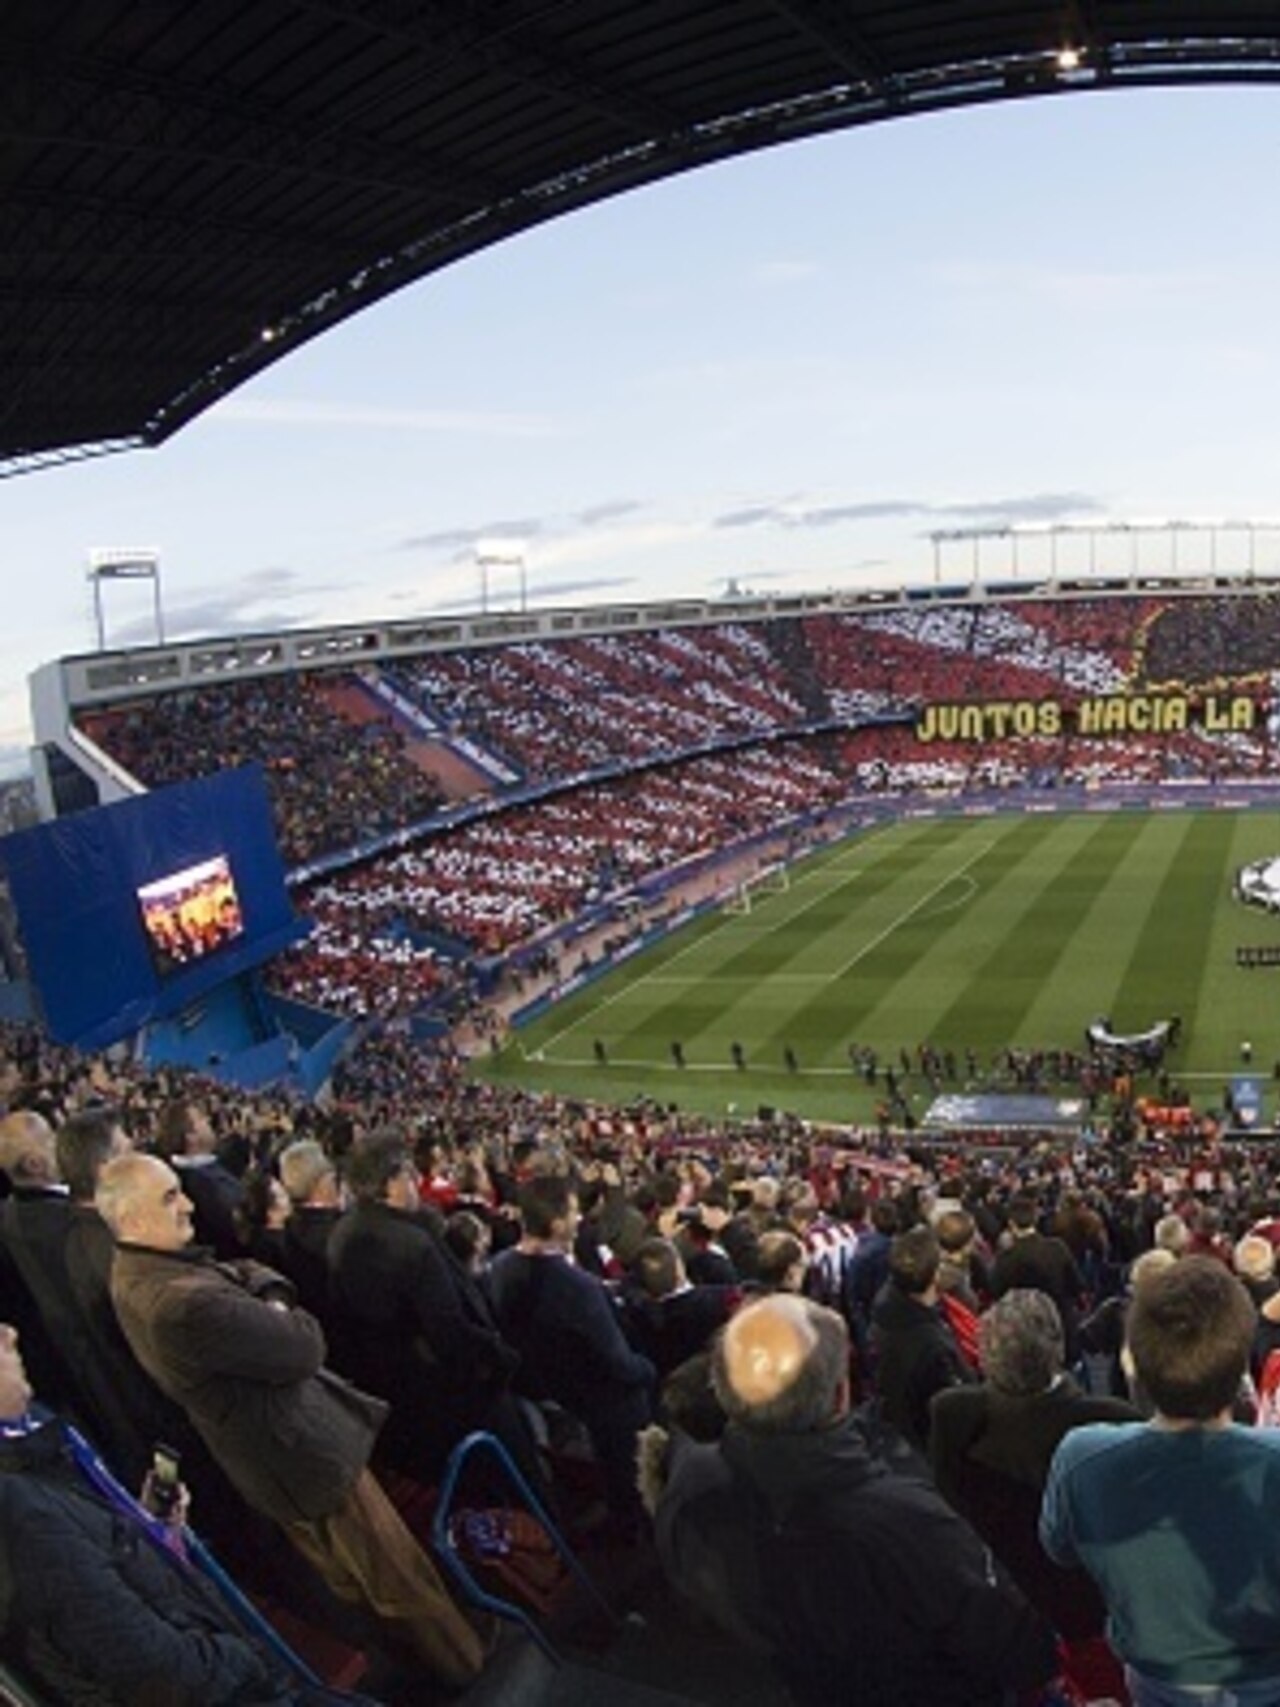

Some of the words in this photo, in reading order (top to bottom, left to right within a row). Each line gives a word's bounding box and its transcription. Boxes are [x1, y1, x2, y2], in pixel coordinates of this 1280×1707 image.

[917, 701, 1061, 742] JUNTOS
[1079, 697, 1187, 733] HACIA
[1205, 697, 1253, 730] LA
